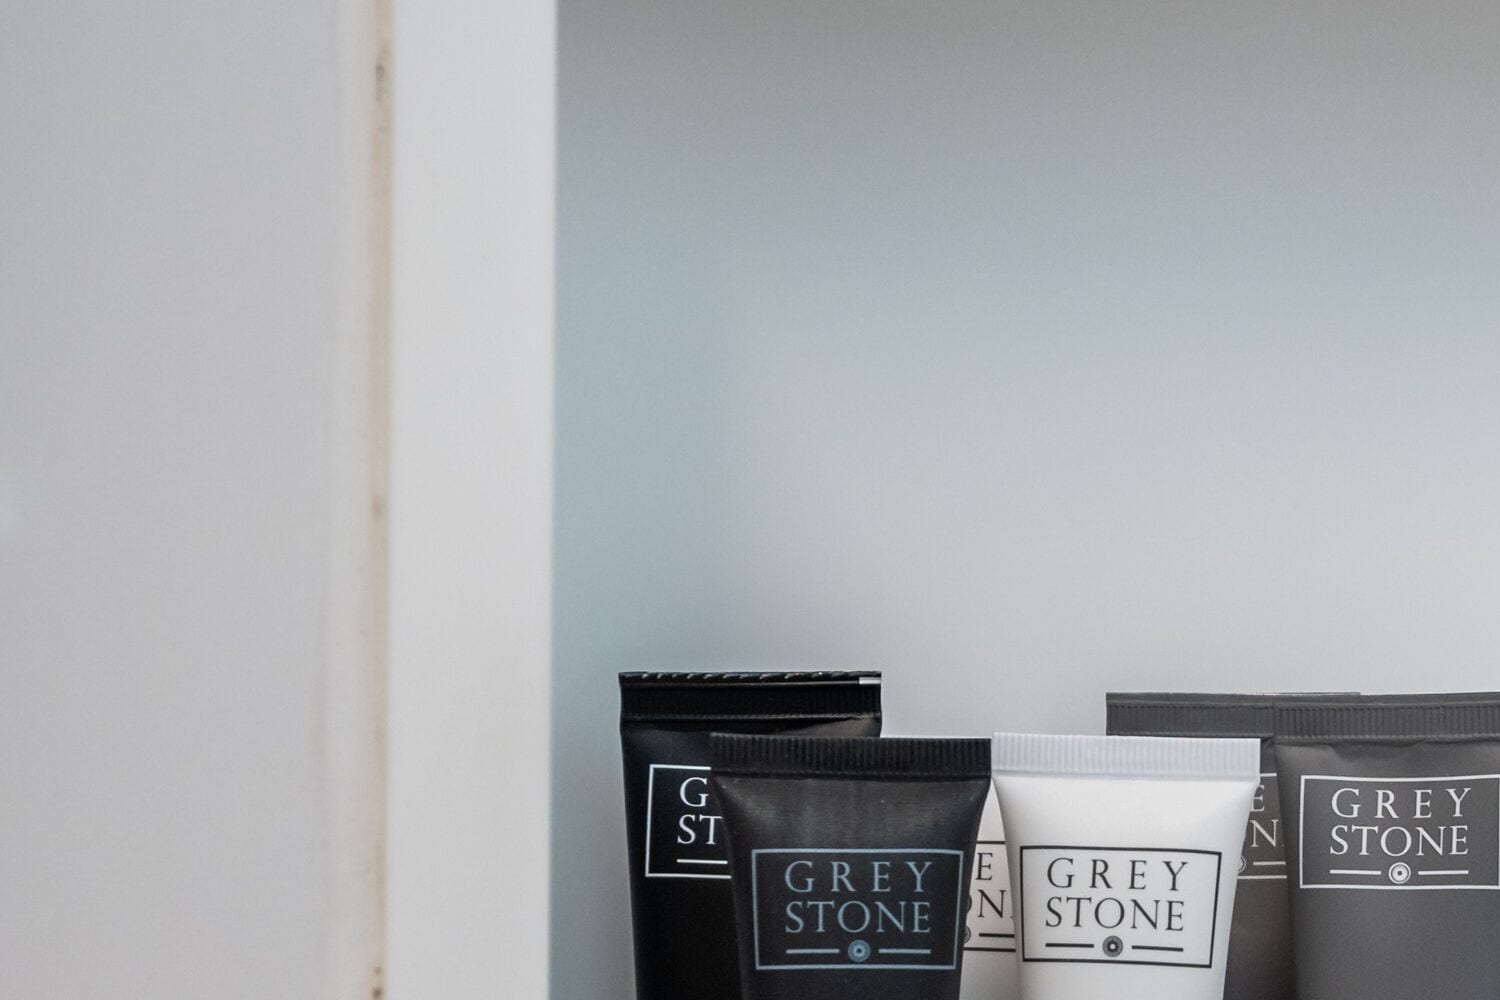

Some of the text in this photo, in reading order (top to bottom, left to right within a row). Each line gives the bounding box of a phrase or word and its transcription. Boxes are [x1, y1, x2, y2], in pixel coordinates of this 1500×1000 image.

[1331, 787, 1472, 819] GREY
[1329, 824, 1469, 857] STONE
[784, 860, 932, 893] GREY
[1046, 857, 1189, 892] GREY
[785, 900, 931, 934] STONE
[1045, 896, 1185, 932] STONE
